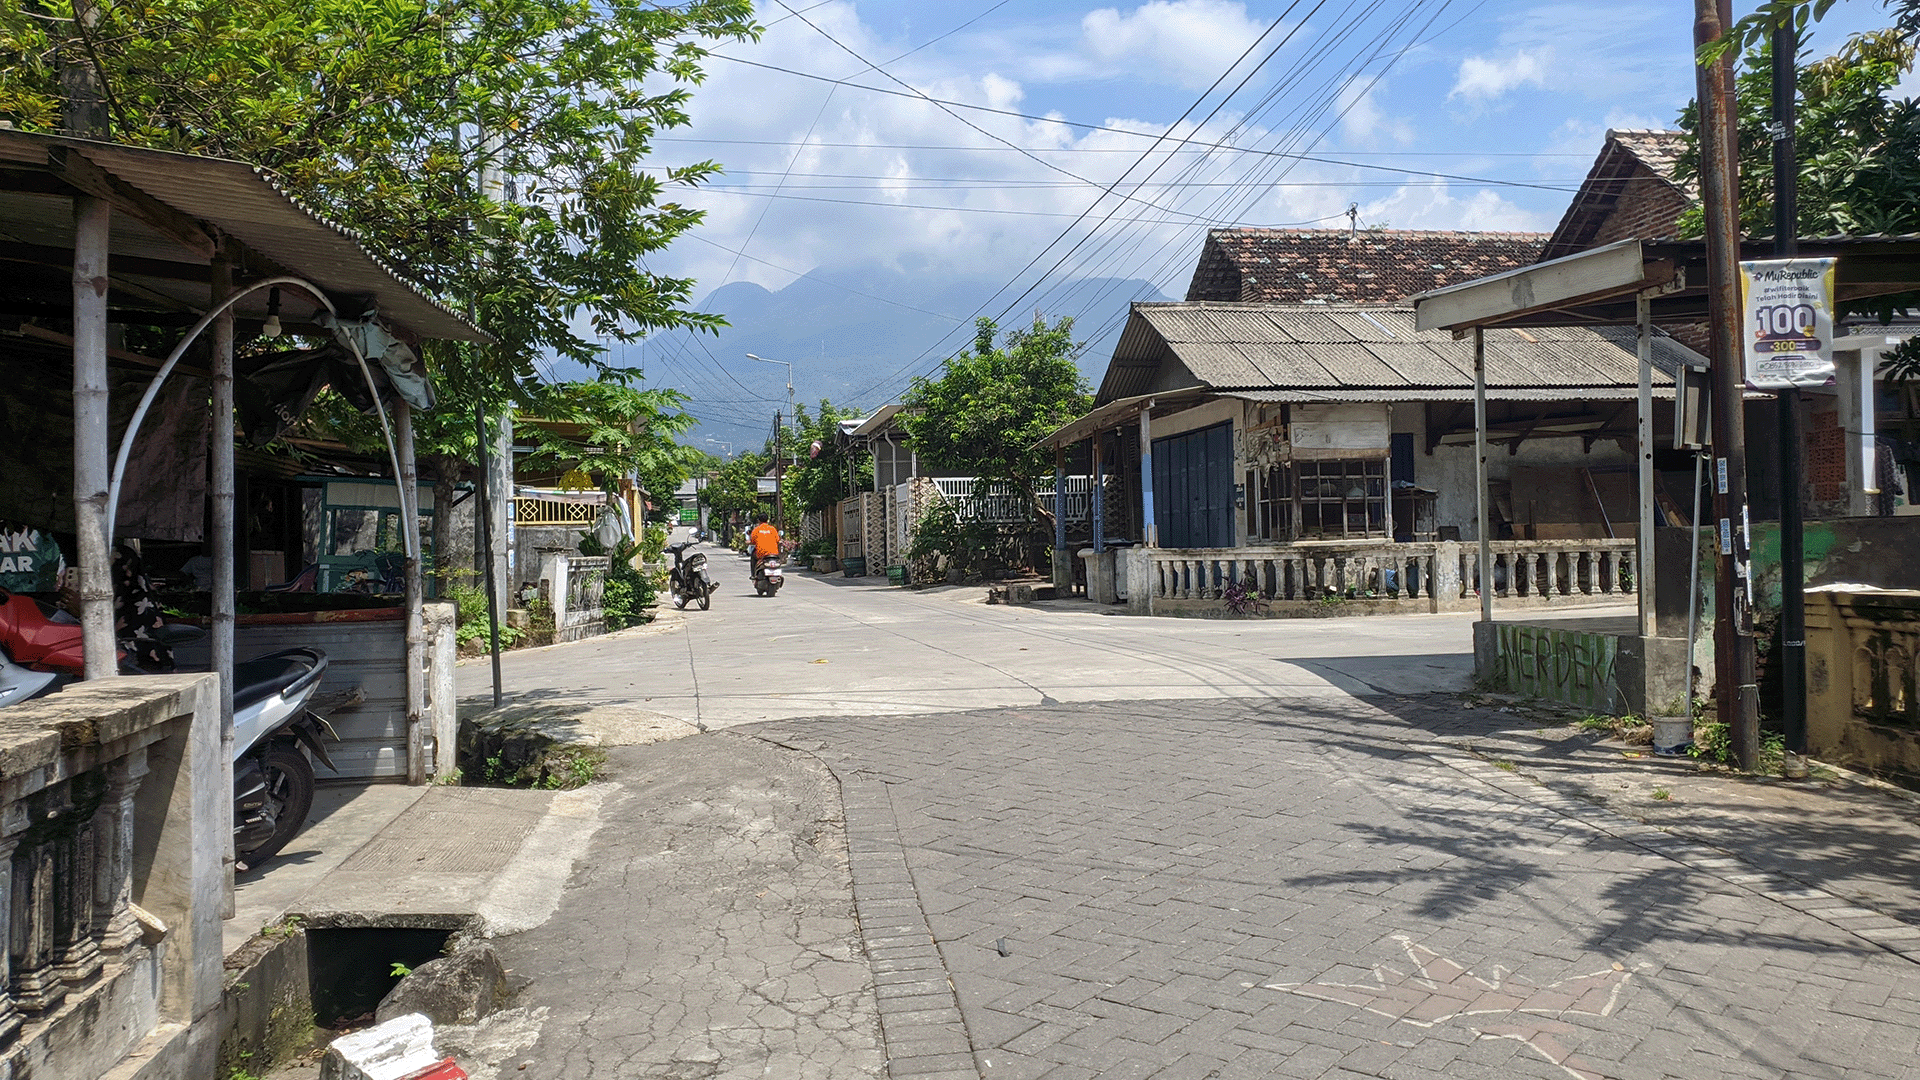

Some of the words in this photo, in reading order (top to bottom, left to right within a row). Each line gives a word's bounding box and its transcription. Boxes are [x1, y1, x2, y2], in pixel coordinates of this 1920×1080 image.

[1764, 269, 1819, 282] MyRepublic
[1755, 294, 1777, 302] Telah
[1756, 303, 1816, 336] 100
[1501, 628, 1617, 690] MERDEKA
